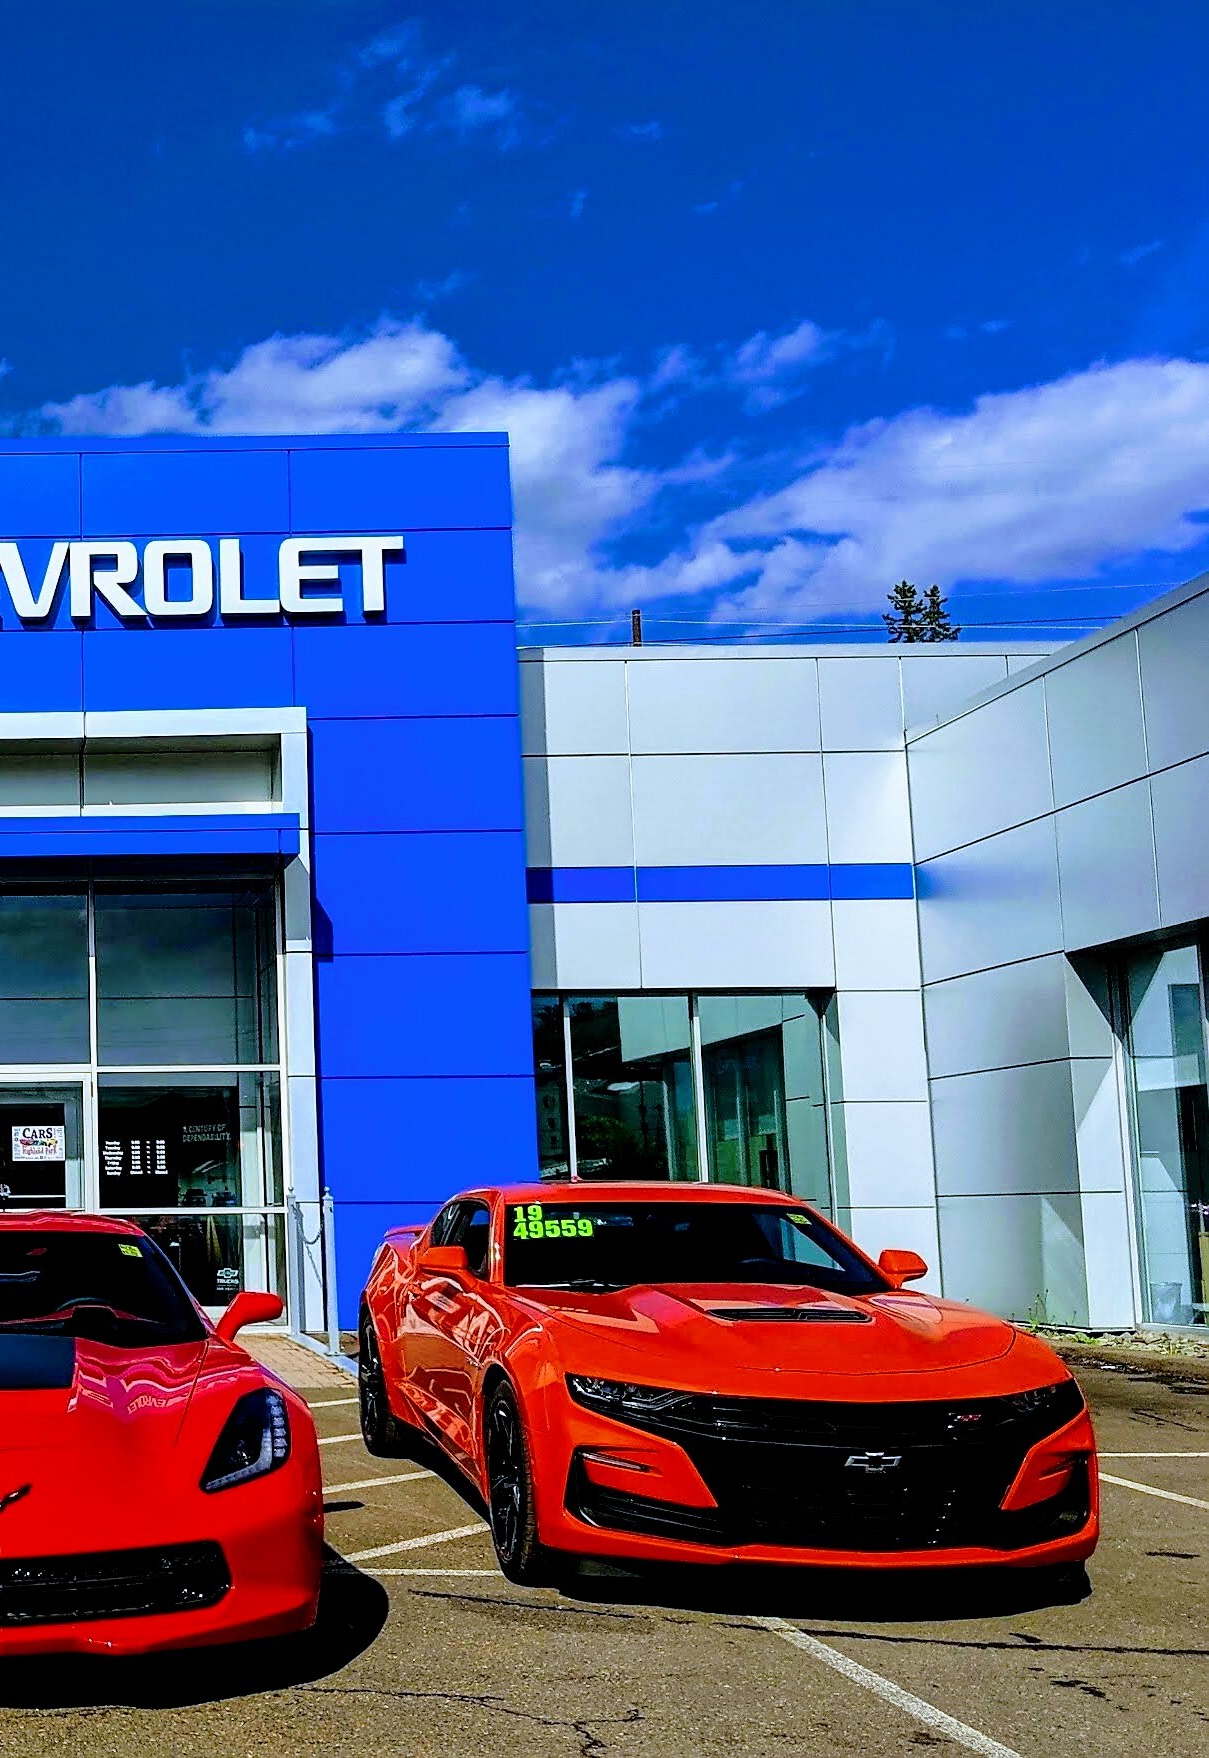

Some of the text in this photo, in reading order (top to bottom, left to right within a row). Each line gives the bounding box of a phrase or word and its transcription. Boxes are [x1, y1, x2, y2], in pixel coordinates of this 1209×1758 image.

[22, 1127, 53, 1139] CARS
[514, 1205, 542, 1222] 19
[513, 1219, 593, 1239] 49559
